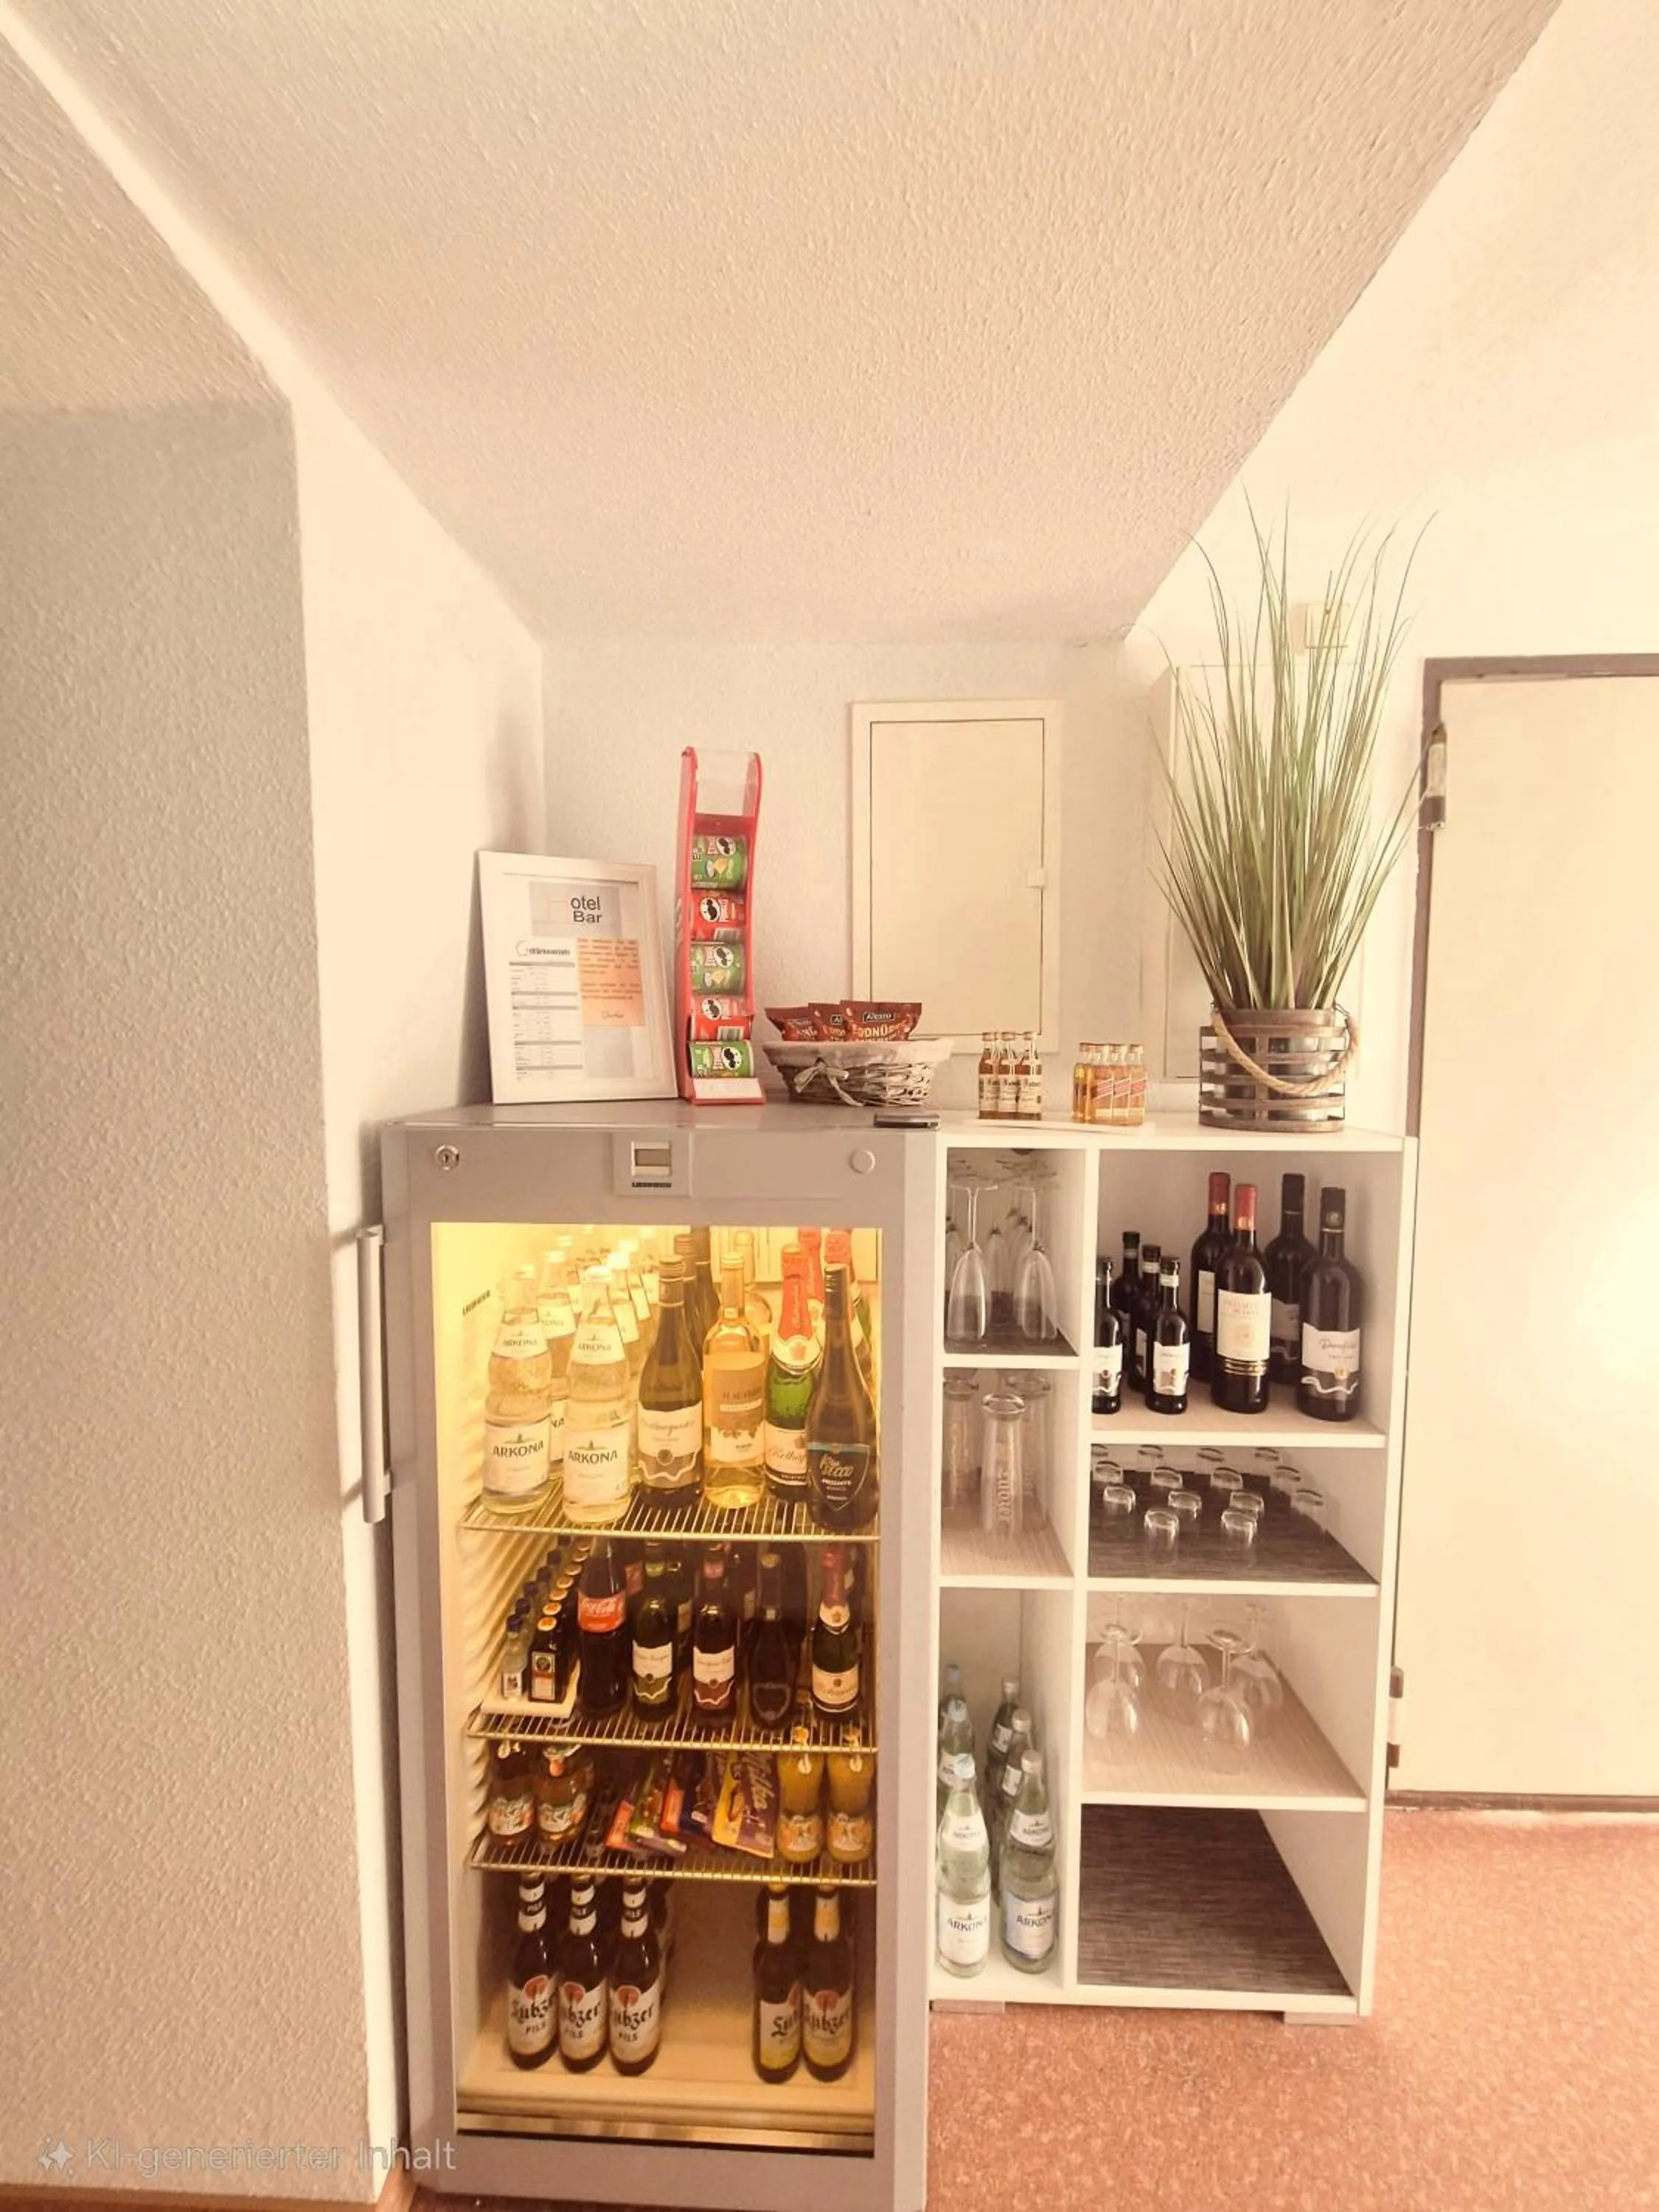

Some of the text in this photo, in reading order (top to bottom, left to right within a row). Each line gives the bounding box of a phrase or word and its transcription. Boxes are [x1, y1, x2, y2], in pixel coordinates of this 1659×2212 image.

[571, 896, 601, 910] otel
[573, 911, 602, 923] Bar
[493, 1440, 543, 1458] ARKONA
[568, 1450, 618, 1464] ARKONA
